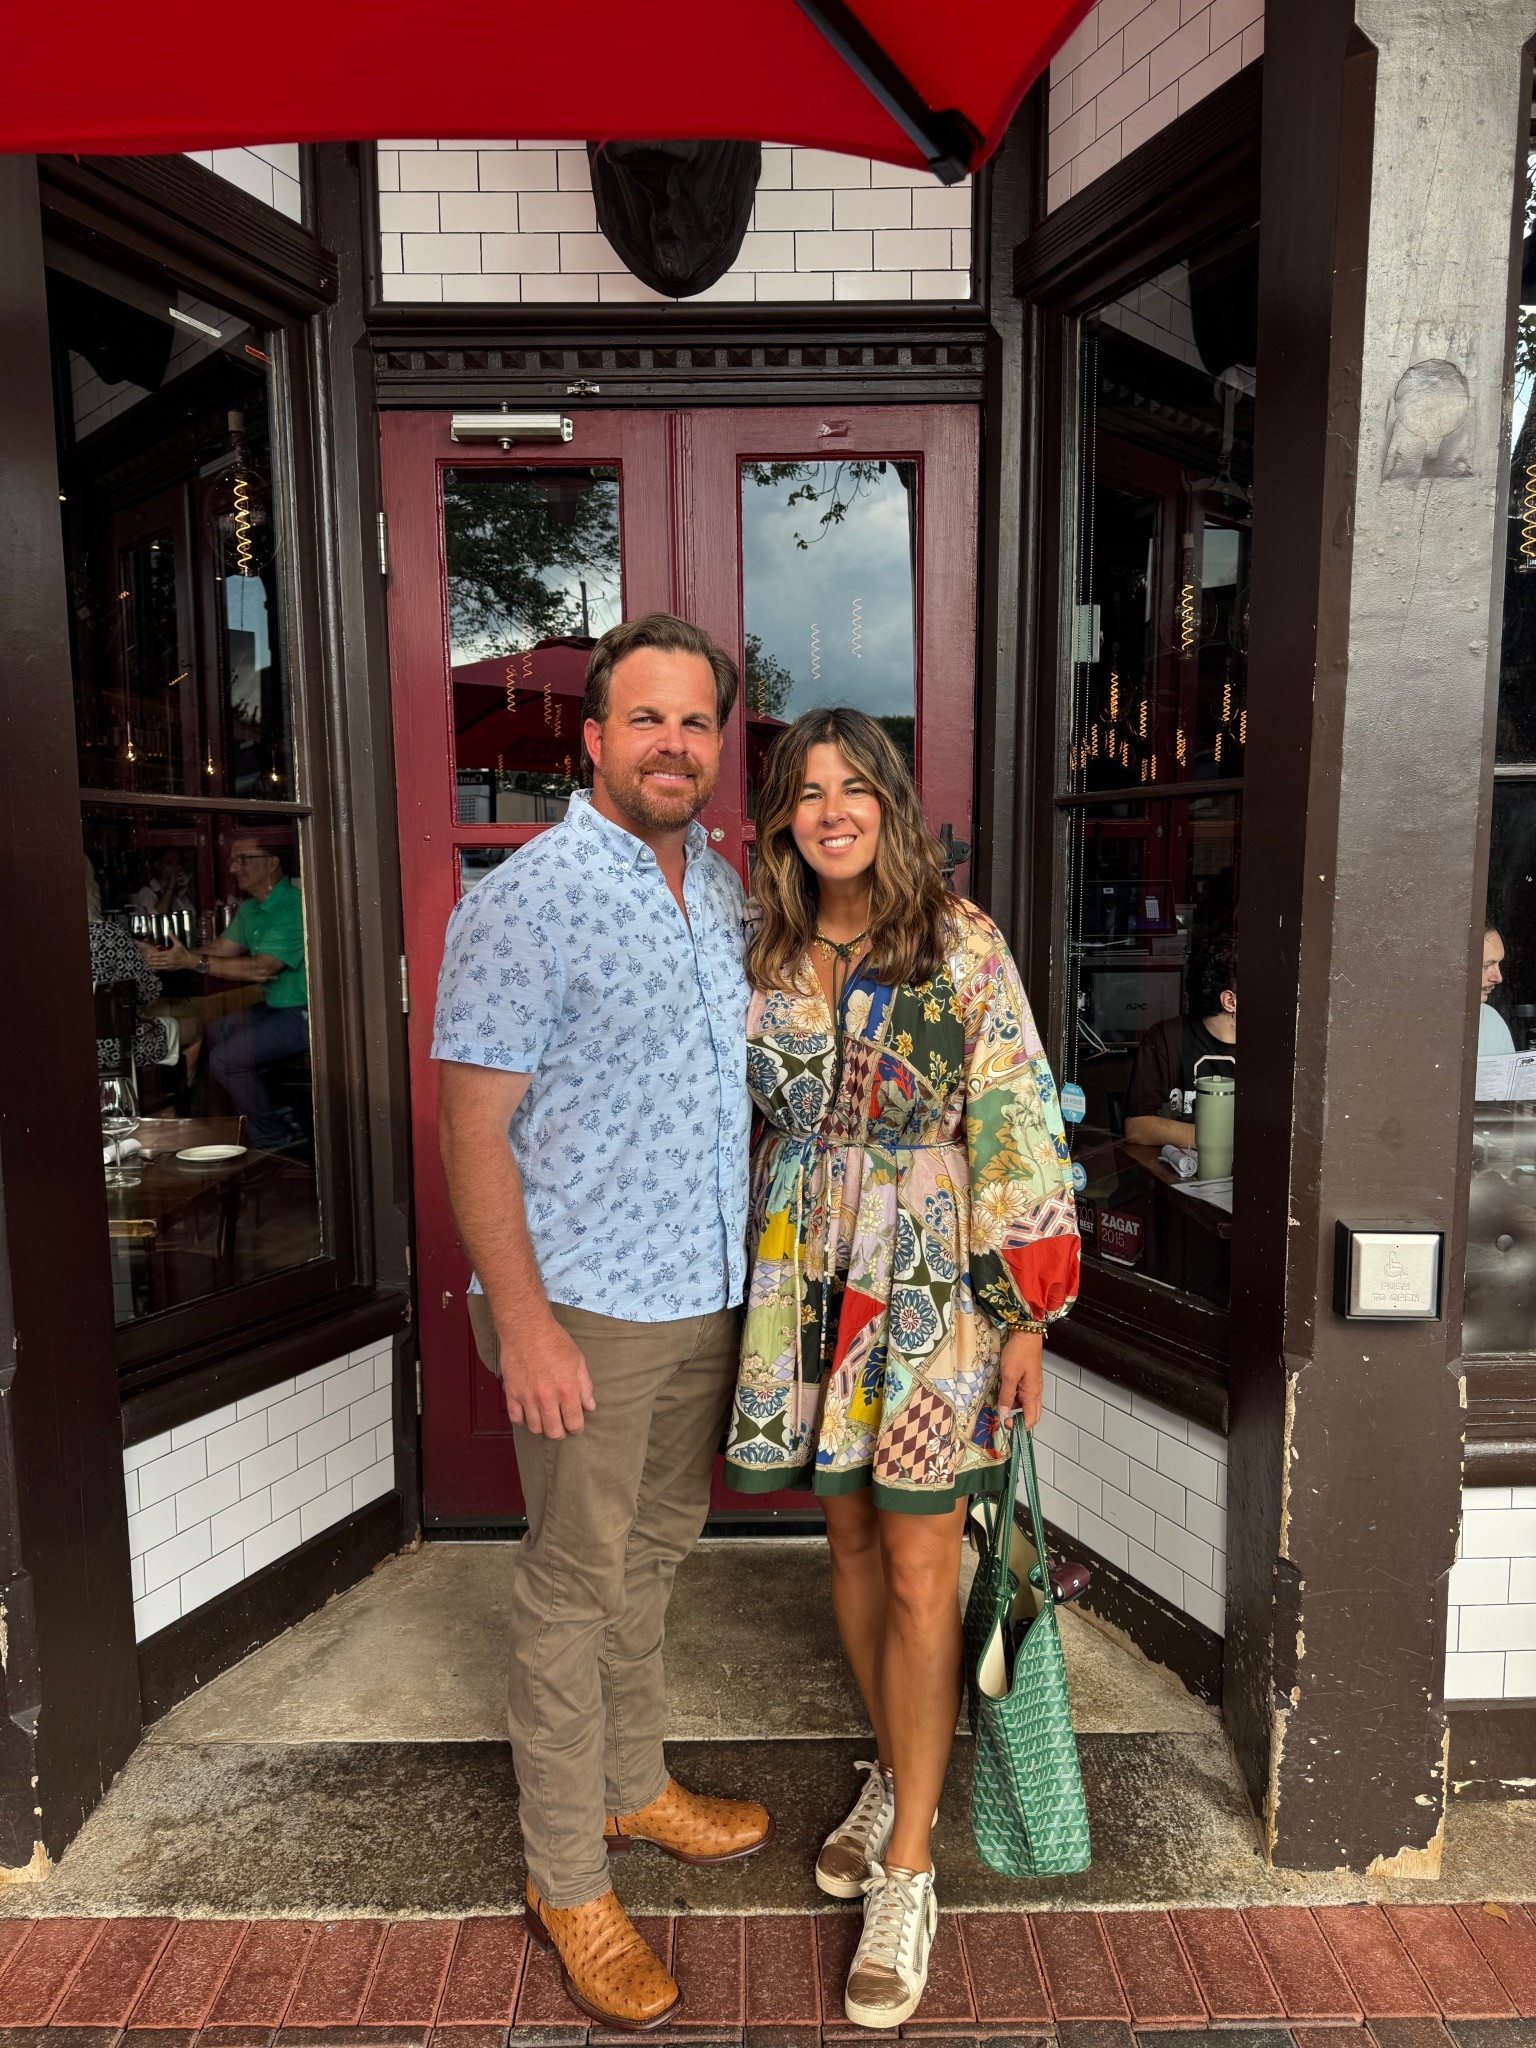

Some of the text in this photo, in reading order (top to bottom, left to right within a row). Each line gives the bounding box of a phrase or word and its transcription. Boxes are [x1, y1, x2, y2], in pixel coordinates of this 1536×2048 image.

[1124, 1003, 1148, 1011] APC
[1080, 1219, 1094, 1231] BEST
[1101, 1212, 1140, 1237] ZAGAT
[1101, 1227, 1125, 1247] 2015
[1380, 1282, 1410, 1291] PUSH
[1372, 1293, 1420, 1302] TO OPEN
